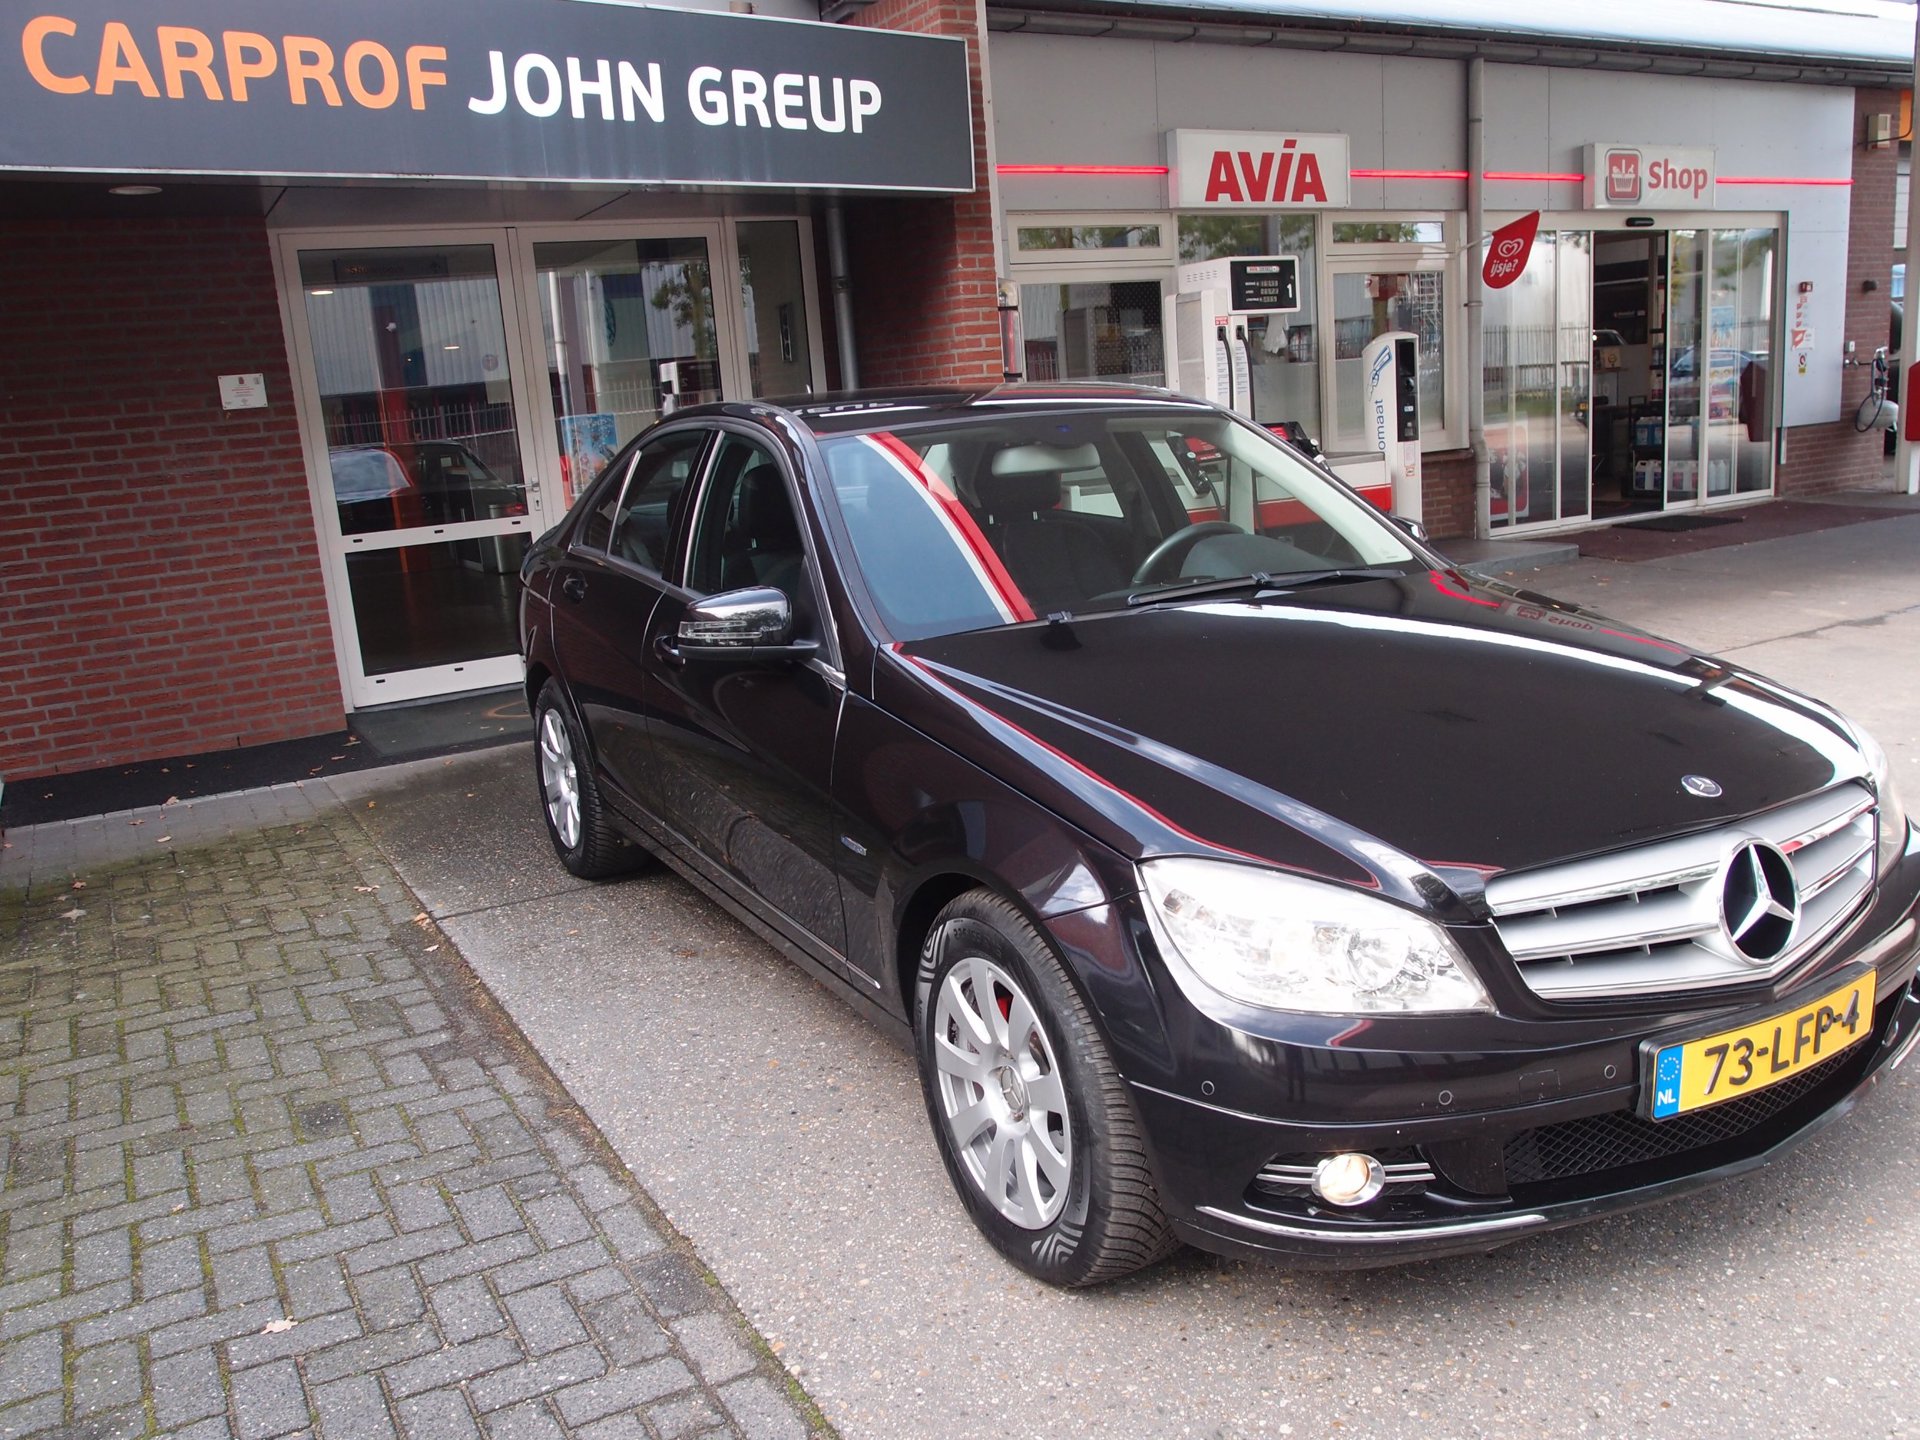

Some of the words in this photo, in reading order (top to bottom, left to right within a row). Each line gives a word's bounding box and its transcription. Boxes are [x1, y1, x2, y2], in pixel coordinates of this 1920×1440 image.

[21, 15, 447, 111] CARPROF
[468, 50, 665, 123] JOHN
[687, 66, 882, 134] GREUP
[1648, 158, 1708, 199] Shop
[1490, 259, 1518, 278] ijsje?
[1286, 283, 1292, 298] 1
[1704, 989, 1860, 1095] 73-LFP-4
[1657, 1089, 1676, 1106] NL
